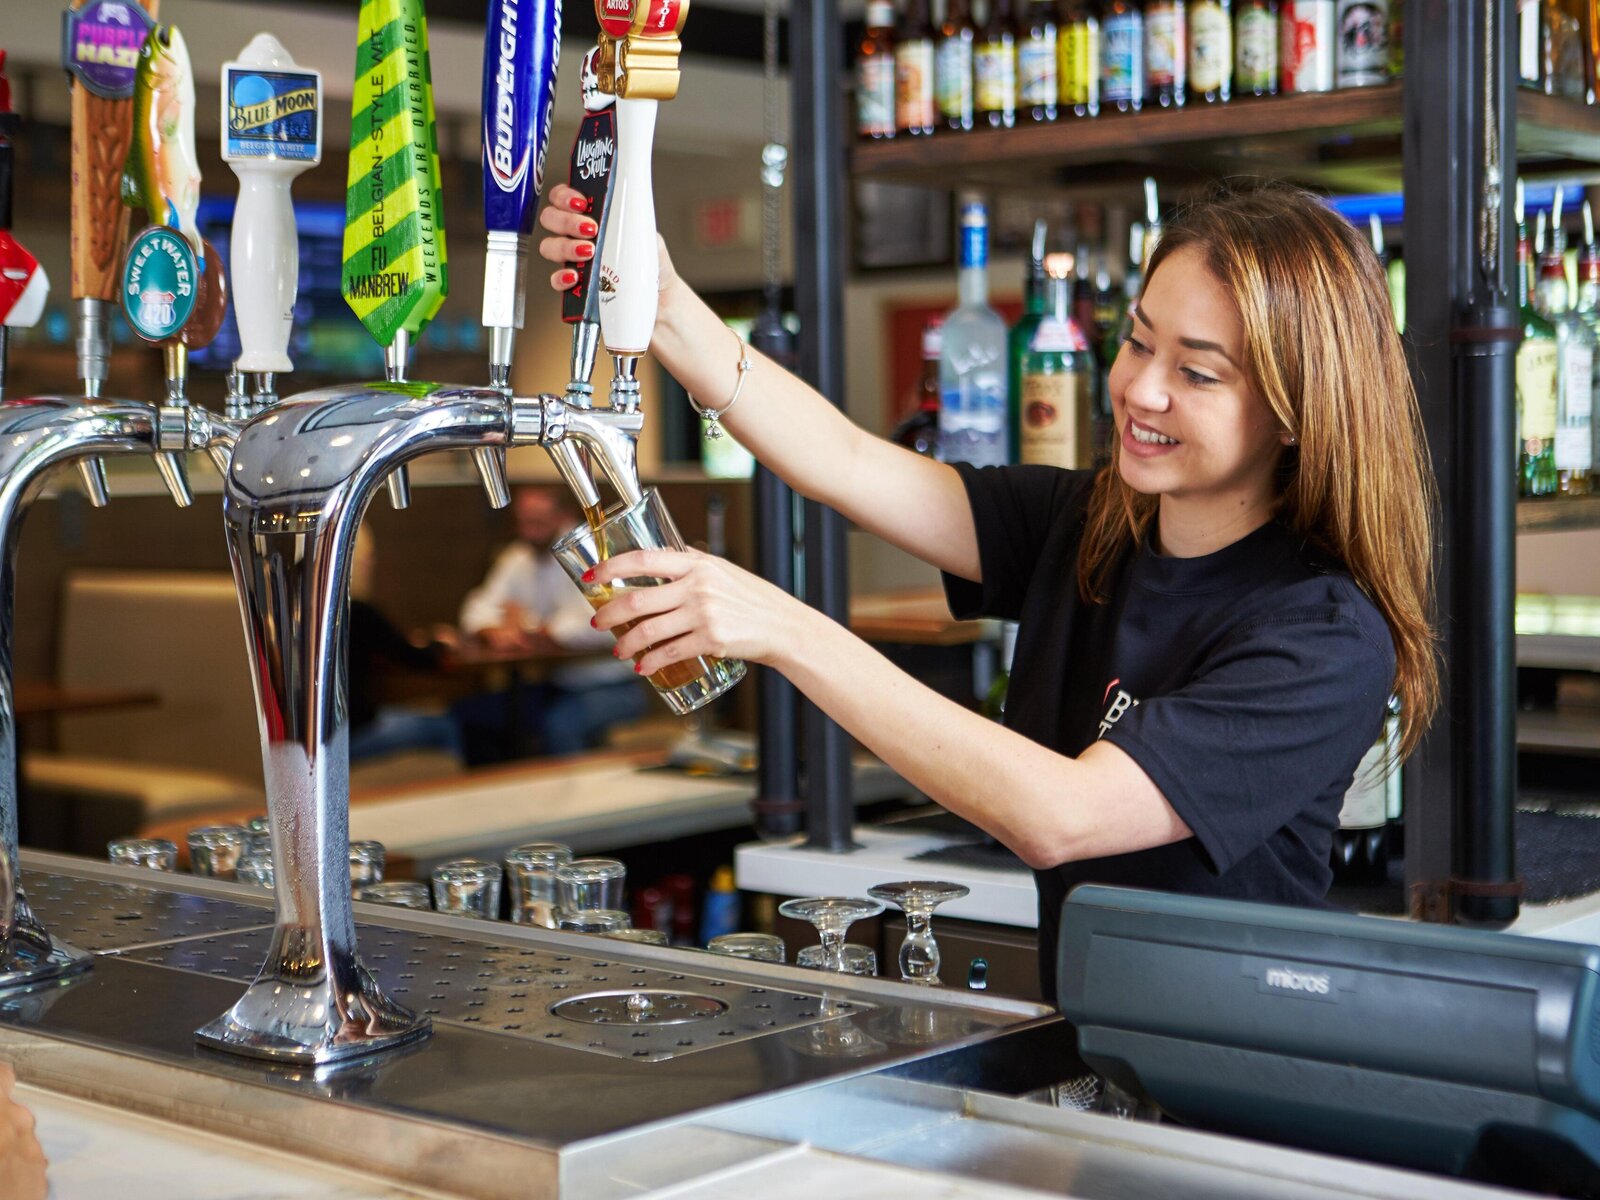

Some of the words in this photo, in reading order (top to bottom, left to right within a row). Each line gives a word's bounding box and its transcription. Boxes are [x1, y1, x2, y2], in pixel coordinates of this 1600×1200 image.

[370, 29, 384, 66] WIT
[229, 106, 272, 132] BLUE
[275, 92, 315, 117] MOON
[370, 74, 385, 238] BELGIAN-STYLE
[495, 96, 514, 178] BUD
[536, 100, 554, 180] BUD
[577, 136, 614, 168] LAUGHING
[413, 141, 429, 175] ARE
[418, 187, 438, 284] WEEKENDS
[349, 272, 410, 300] MANBREW
